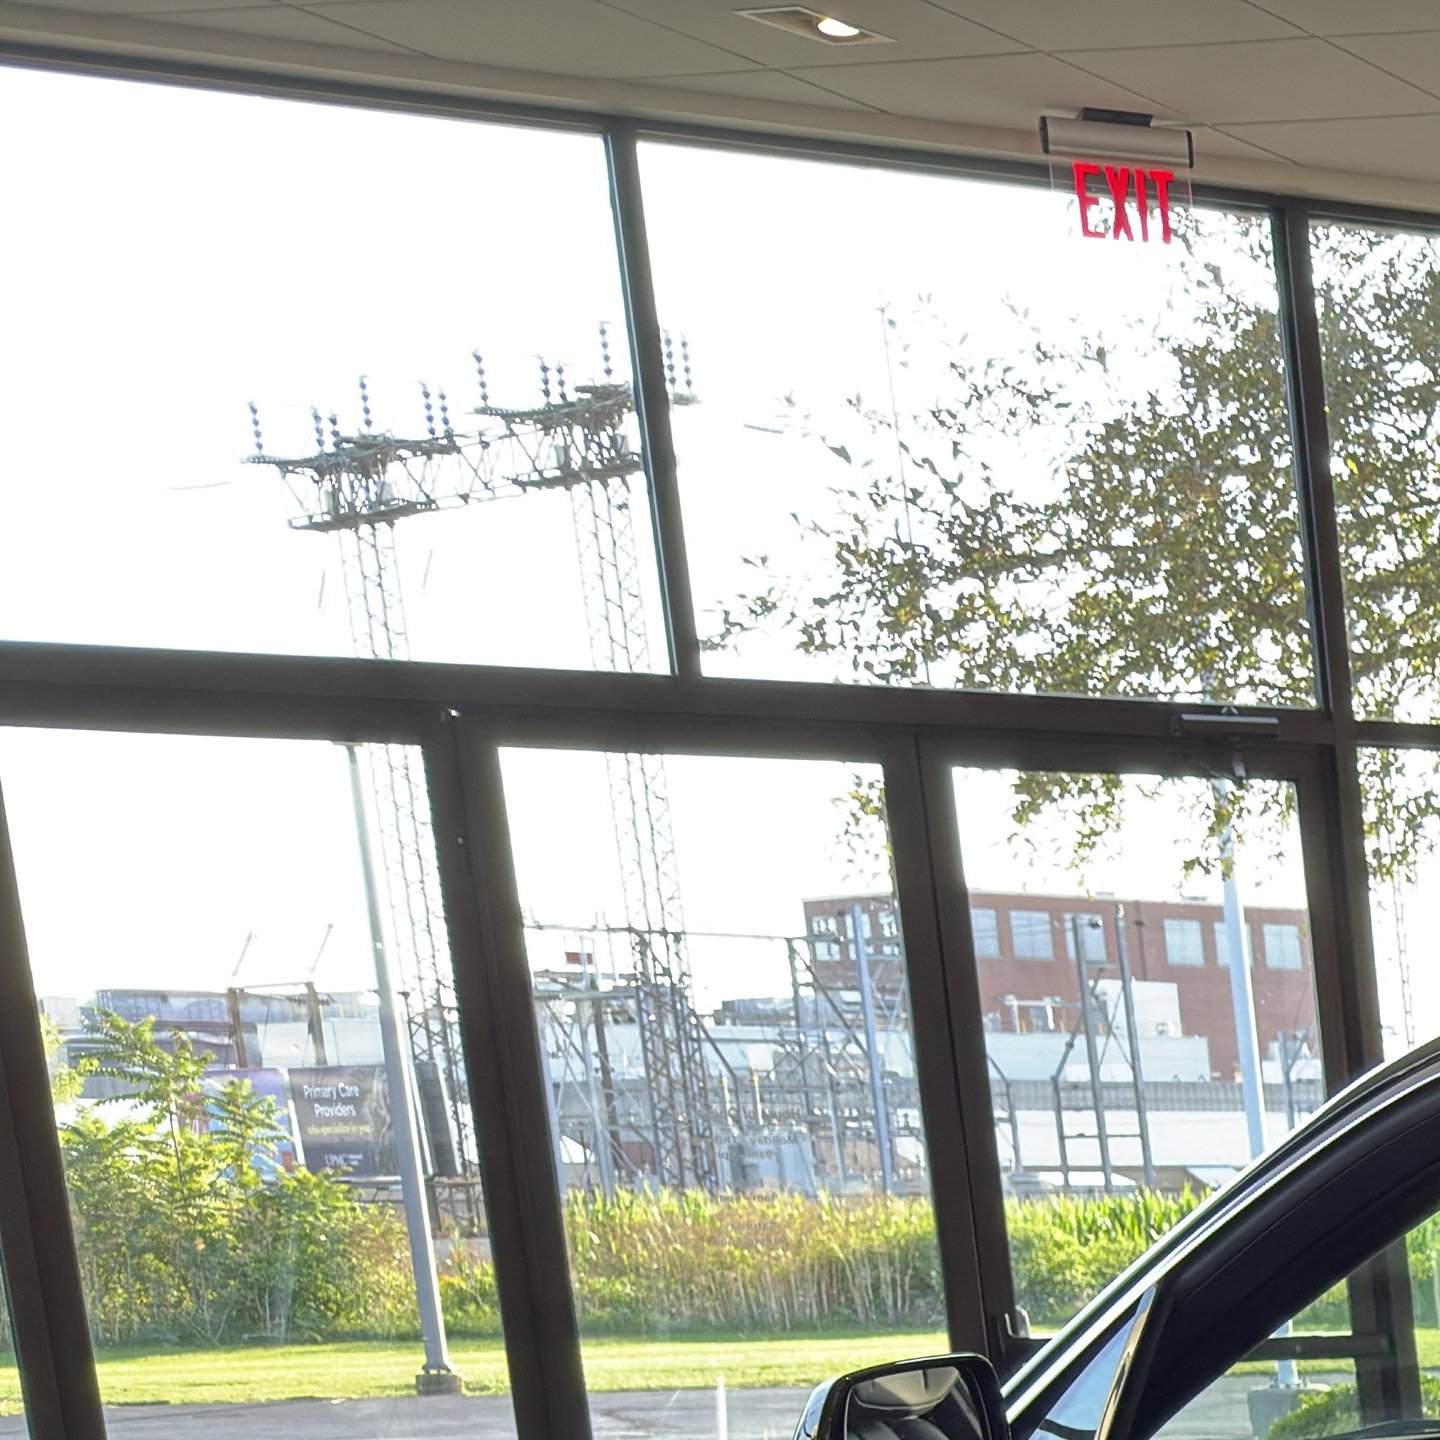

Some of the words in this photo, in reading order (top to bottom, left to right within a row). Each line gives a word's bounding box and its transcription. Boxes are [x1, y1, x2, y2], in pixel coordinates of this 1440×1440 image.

[1072, 161, 1174, 244] EXIT
[303, 1085, 337, 1100] Primary
[338, 1083, 360, 1097] Care
[314, 1102, 356, 1118] Providers
